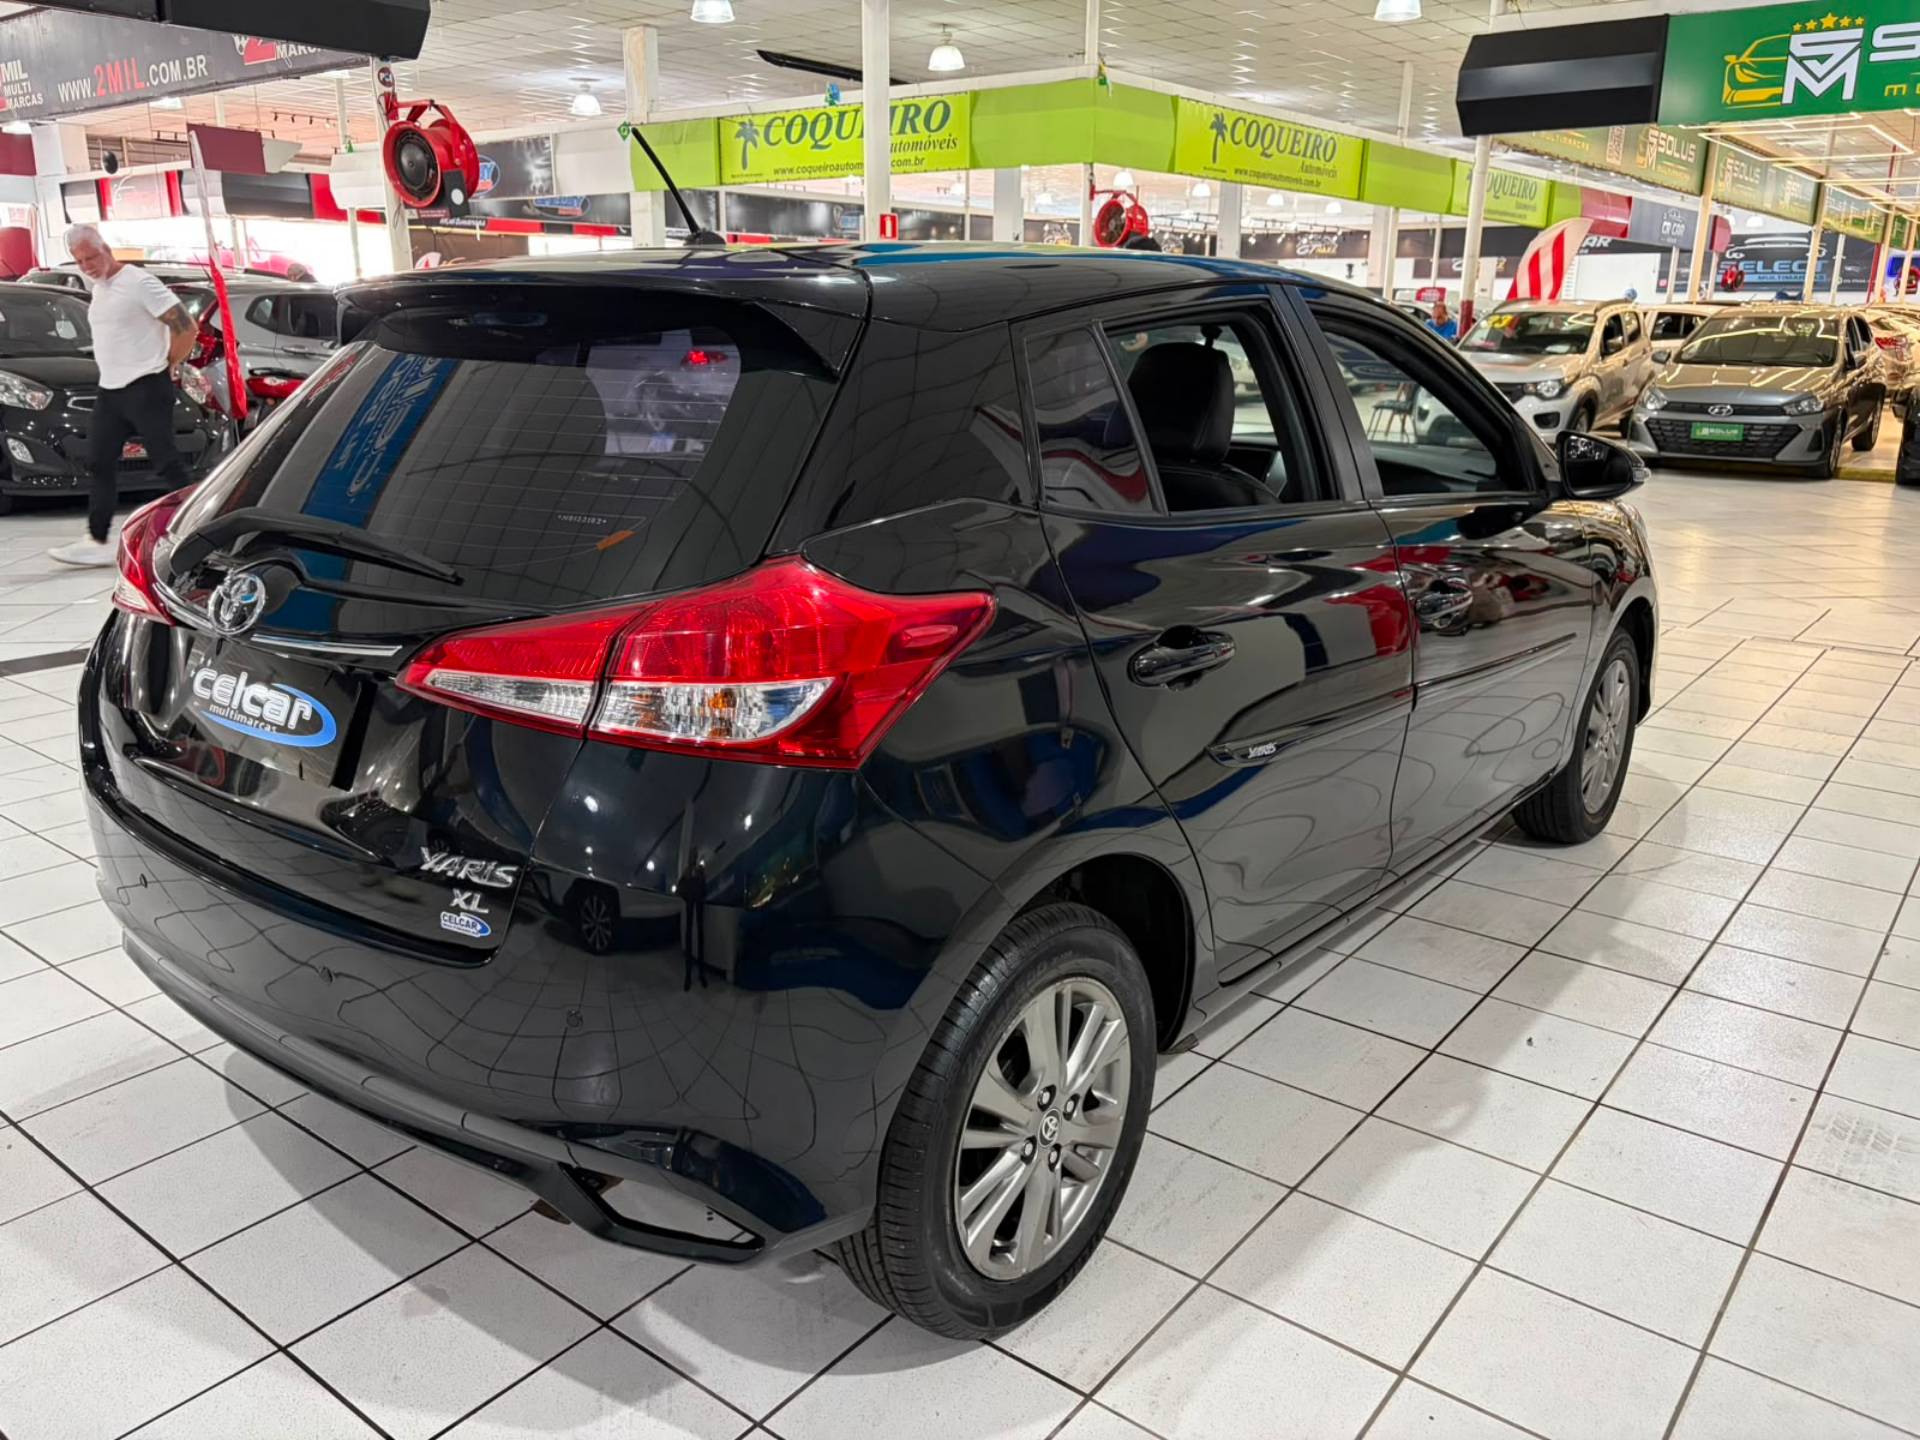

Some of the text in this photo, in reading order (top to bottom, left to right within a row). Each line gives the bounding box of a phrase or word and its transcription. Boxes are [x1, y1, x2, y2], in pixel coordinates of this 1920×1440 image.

[4, 80, 31, 96] MULTI
[57, 54, 208, 103] WWW.2MIL.COM.BR
[763, 100, 951, 150] COQUIRO
[1230, 116, 1337, 163] COQUEIRO
[889, 134, 958, 154] utomóveis
[1658, 132, 1696, 163] SOLUS
[193, 667, 313, 729] celcar
[209, 703, 278, 733] multimarcas
[420, 846, 519, 888] YARIS
[449, 888, 490, 914] XL
[442, 913, 479, 931] CELCAR
